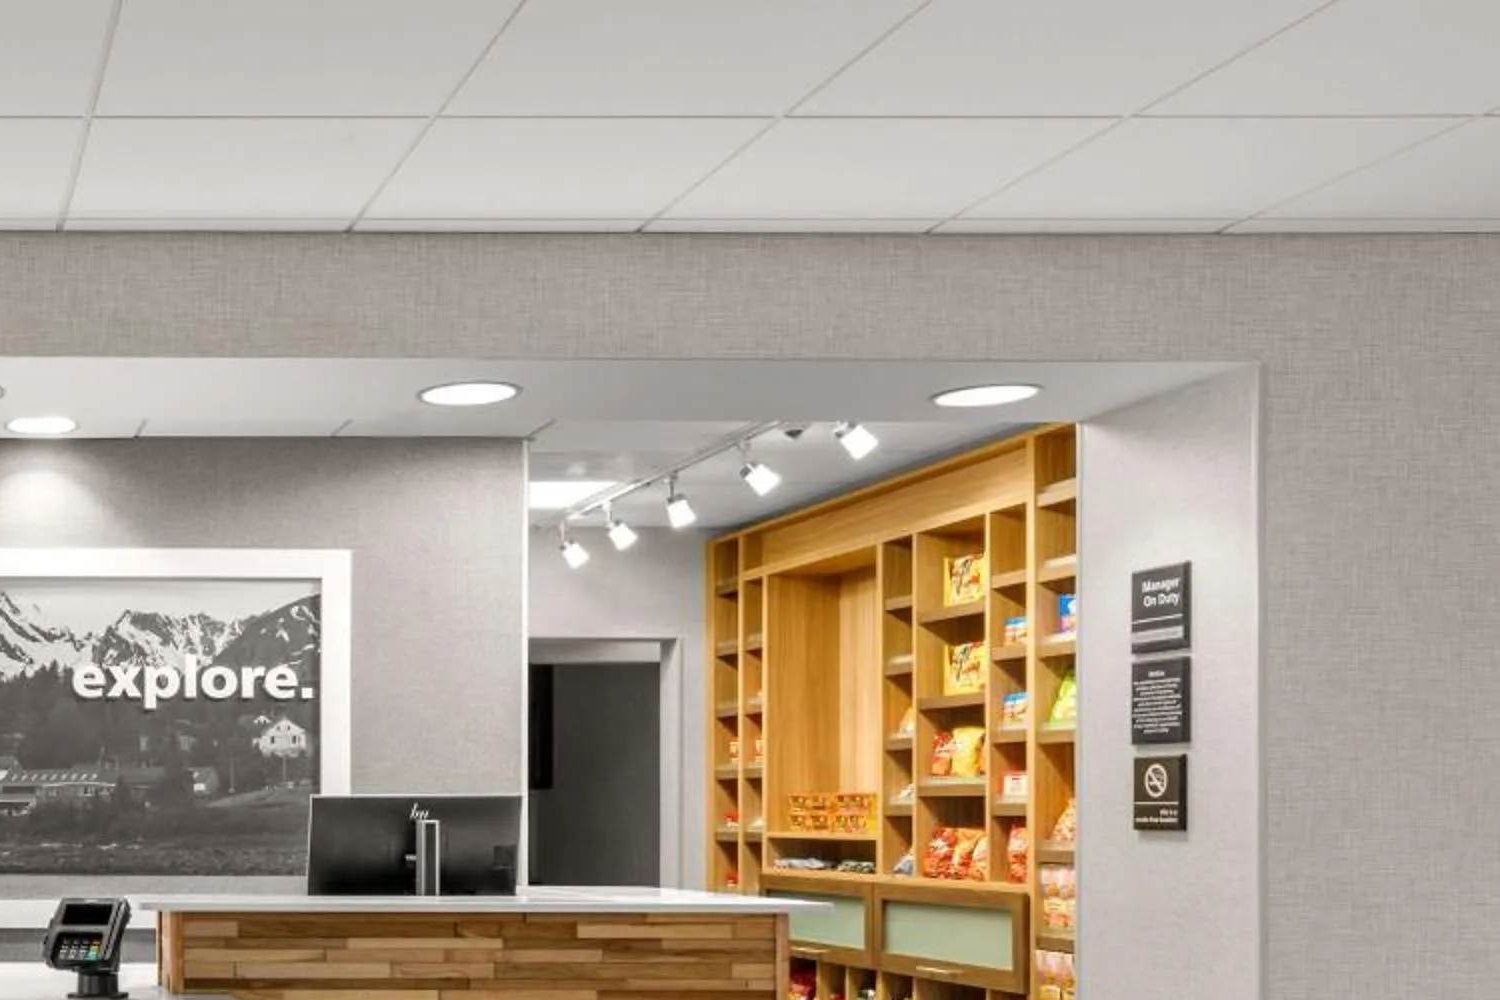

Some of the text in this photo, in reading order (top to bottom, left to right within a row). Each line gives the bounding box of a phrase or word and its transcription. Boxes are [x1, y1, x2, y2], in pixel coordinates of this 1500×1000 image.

[1143, 593, 1180, 607] On Duty
[72, 653, 314, 709] explore.
